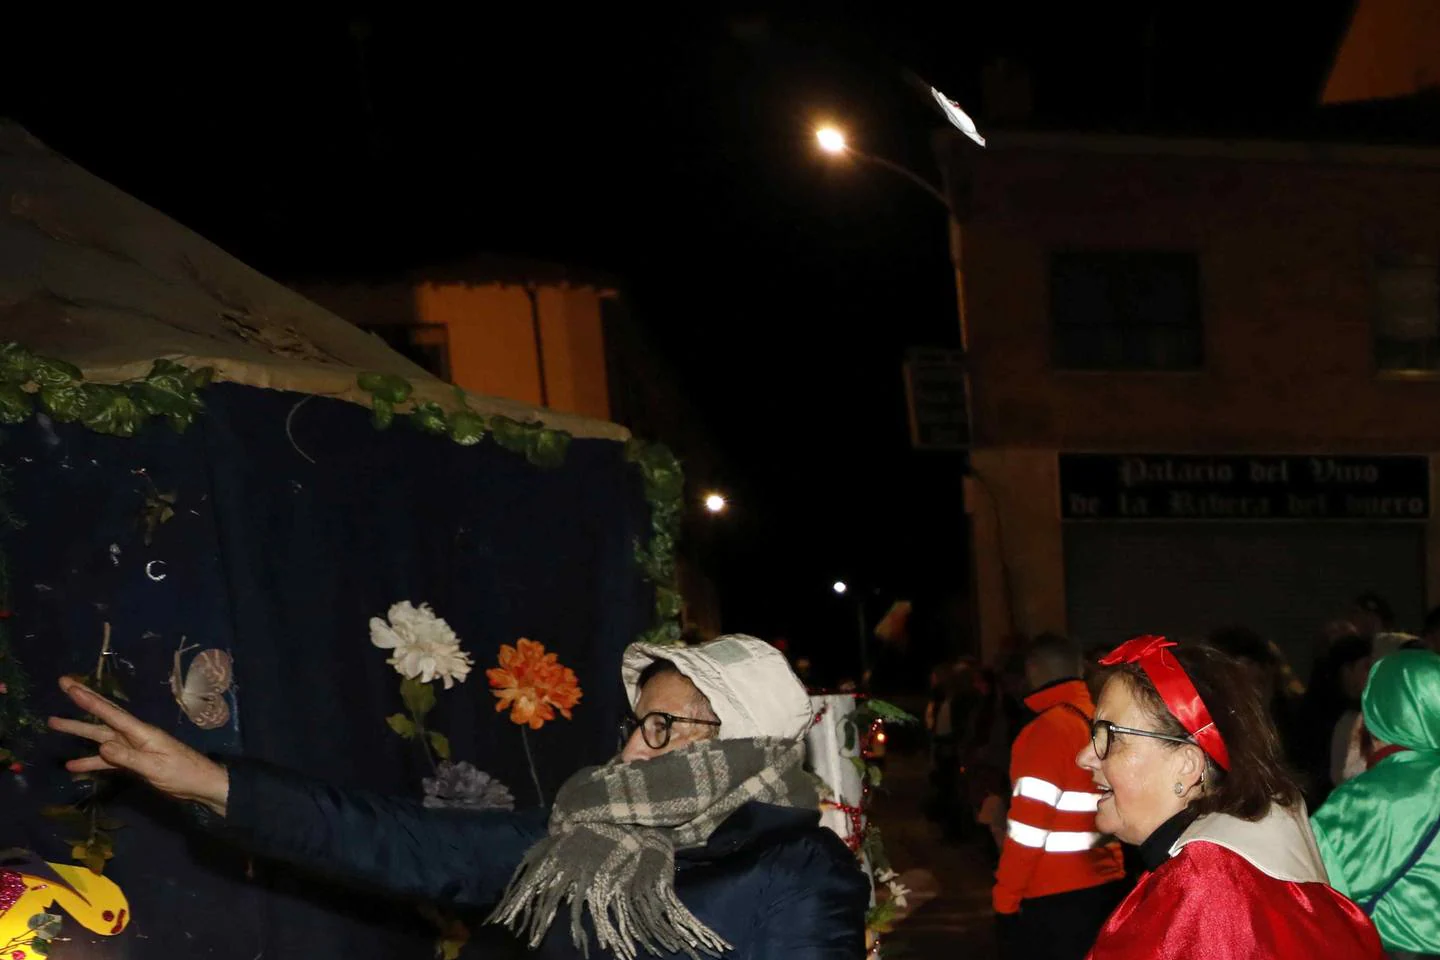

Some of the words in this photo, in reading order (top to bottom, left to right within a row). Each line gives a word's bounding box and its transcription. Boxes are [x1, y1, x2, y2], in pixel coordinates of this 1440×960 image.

[1118, 458, 1232, 487] Palacio
[1248, 459, 1289, 482] del
[1309, 457, 1379, 482] Vino
[1069, 492, 1101, 514] de
[1117, 491, 1150, 514] la
[1169, 490, 1270, 515] Ribera
[1286, 492, 1328, 515] del
